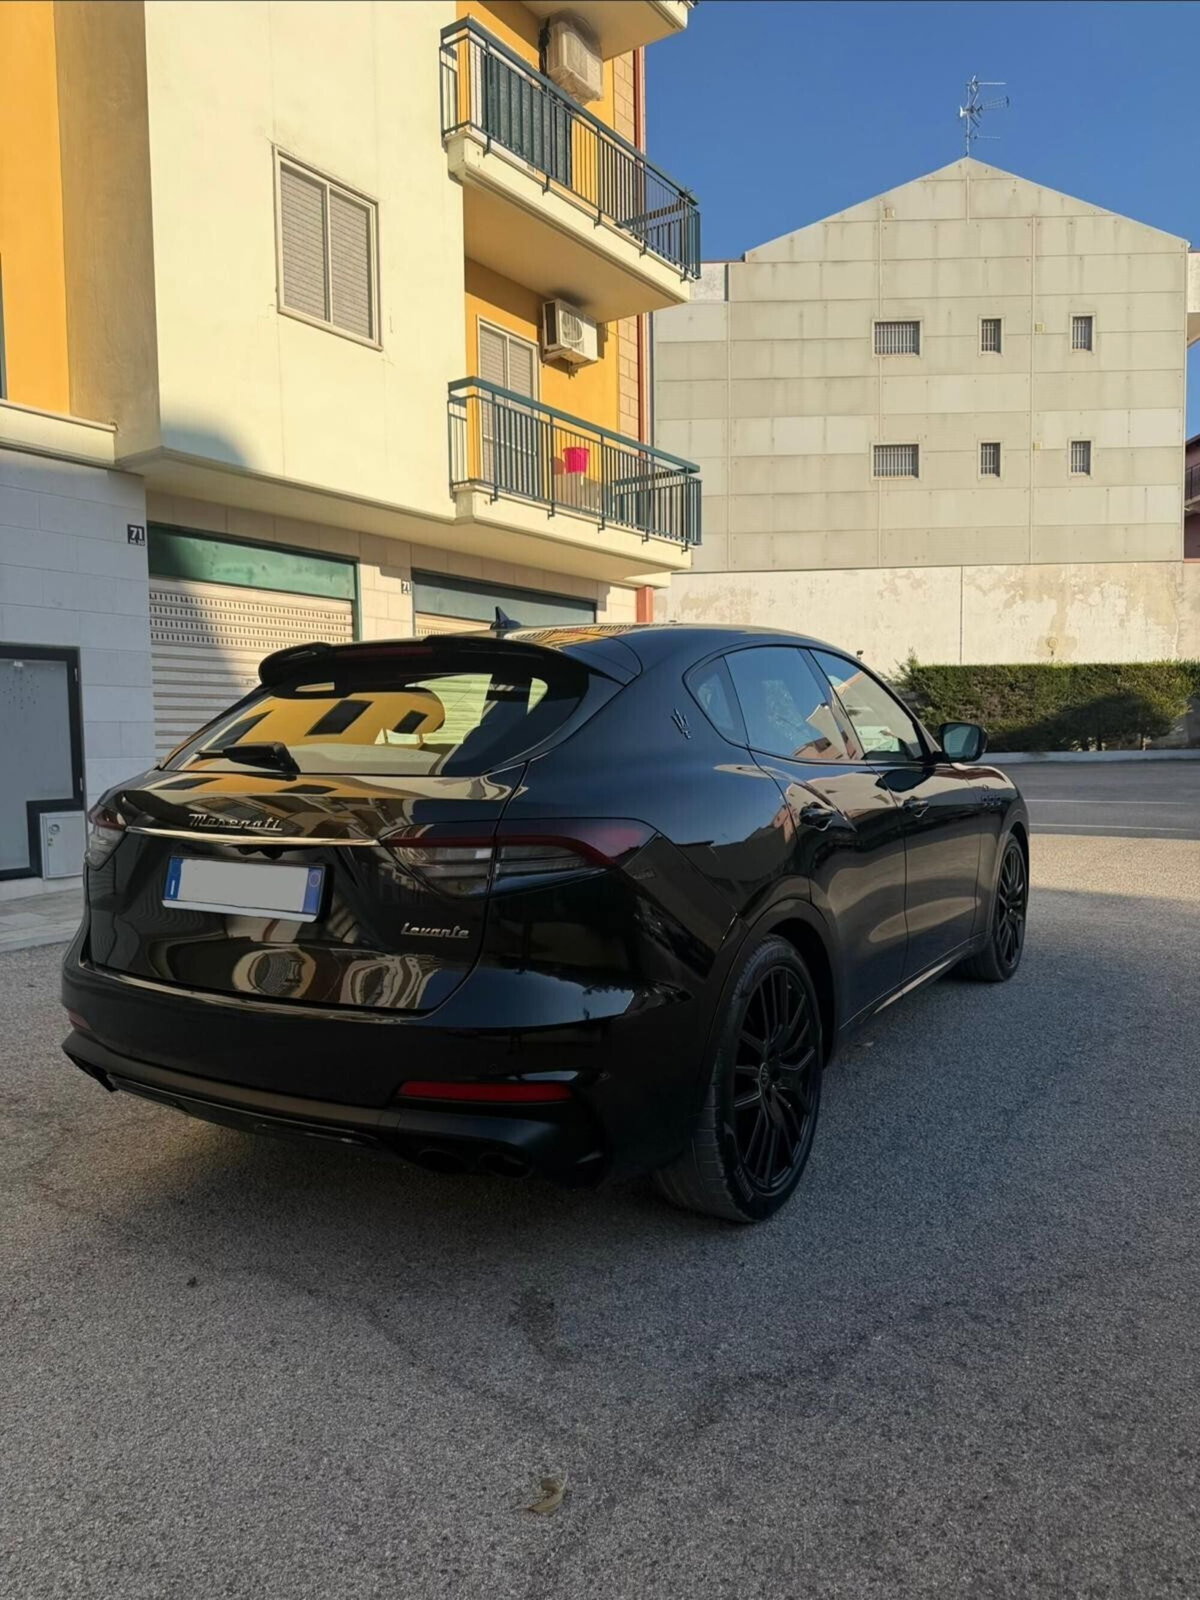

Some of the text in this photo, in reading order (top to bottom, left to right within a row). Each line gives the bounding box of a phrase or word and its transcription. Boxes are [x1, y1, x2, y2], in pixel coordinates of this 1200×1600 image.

[130, 526, 143, 540] 71
[188, 813, 283, 831] Maserati
[400, 922, 469, 939] Levante
